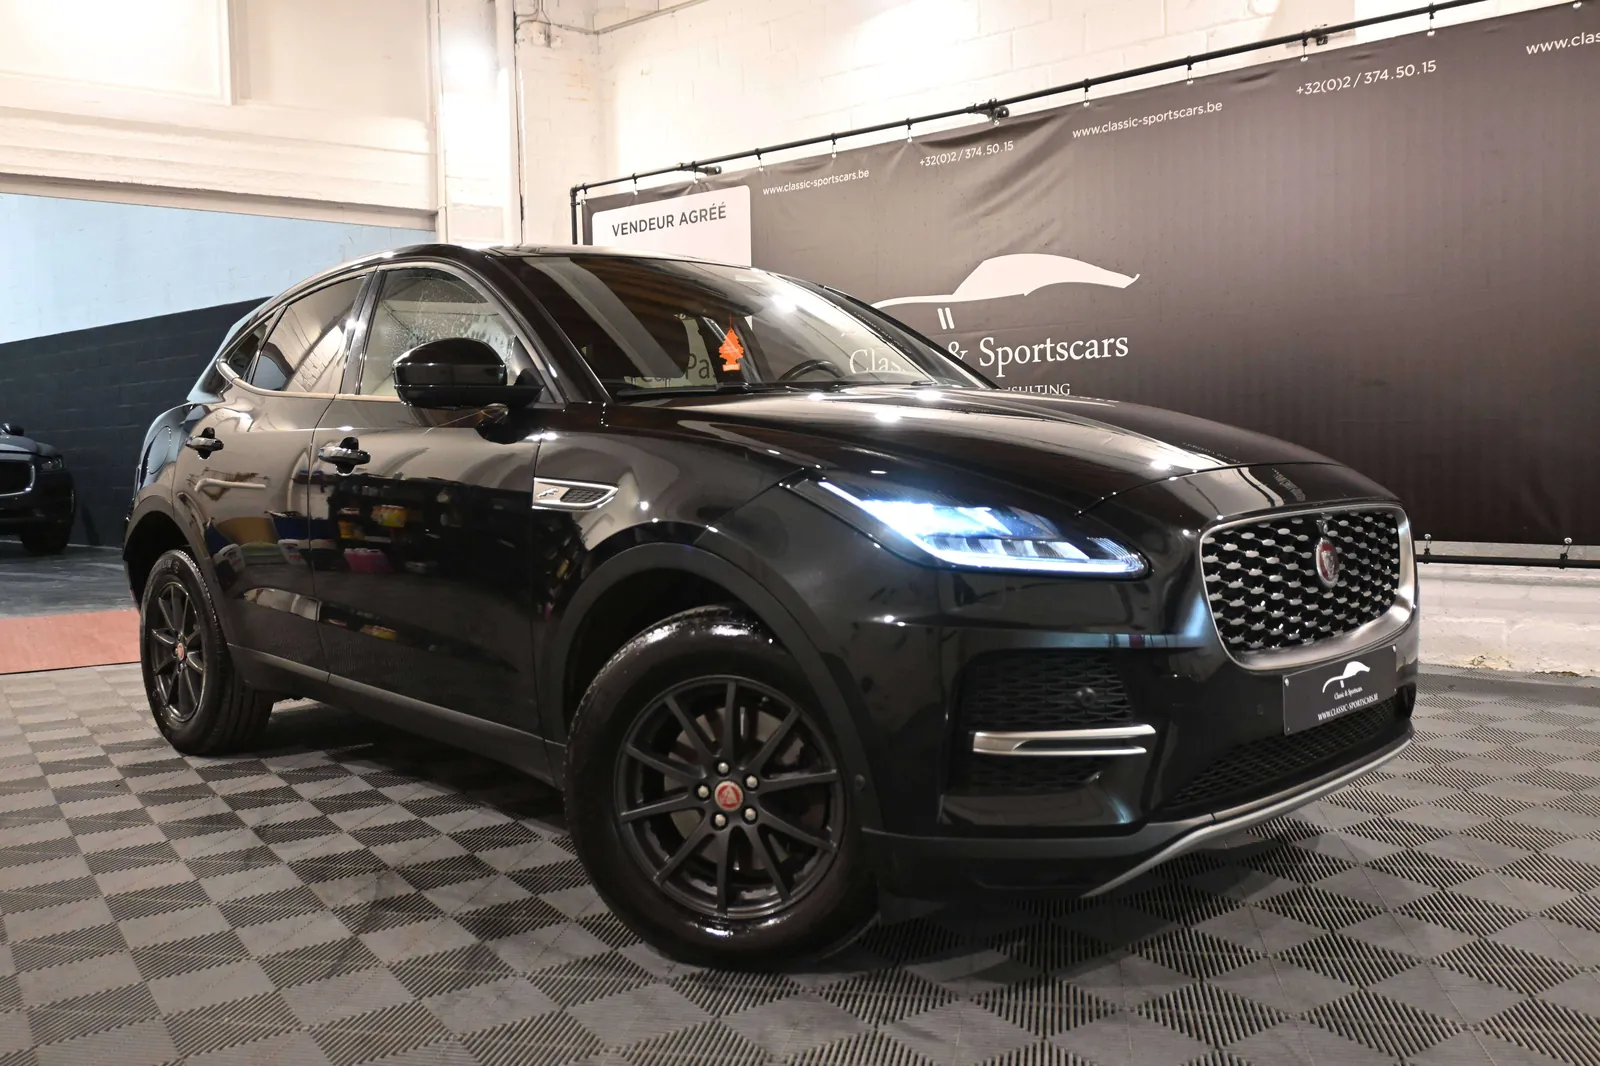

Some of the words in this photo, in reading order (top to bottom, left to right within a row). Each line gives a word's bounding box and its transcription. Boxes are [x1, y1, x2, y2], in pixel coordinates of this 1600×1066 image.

[1526, 32, 1600, 55] www.clas
[1072, 102, 1223, 138] www.classic-sportscars.be
[762, 169, 870, 196] www.classic-sportscars.be
[612, 214, 675, 237] VENDEUR
[679, 202, 727, 226] AGRÉÉ
[979, 336, 1129, 378] Sportscars
